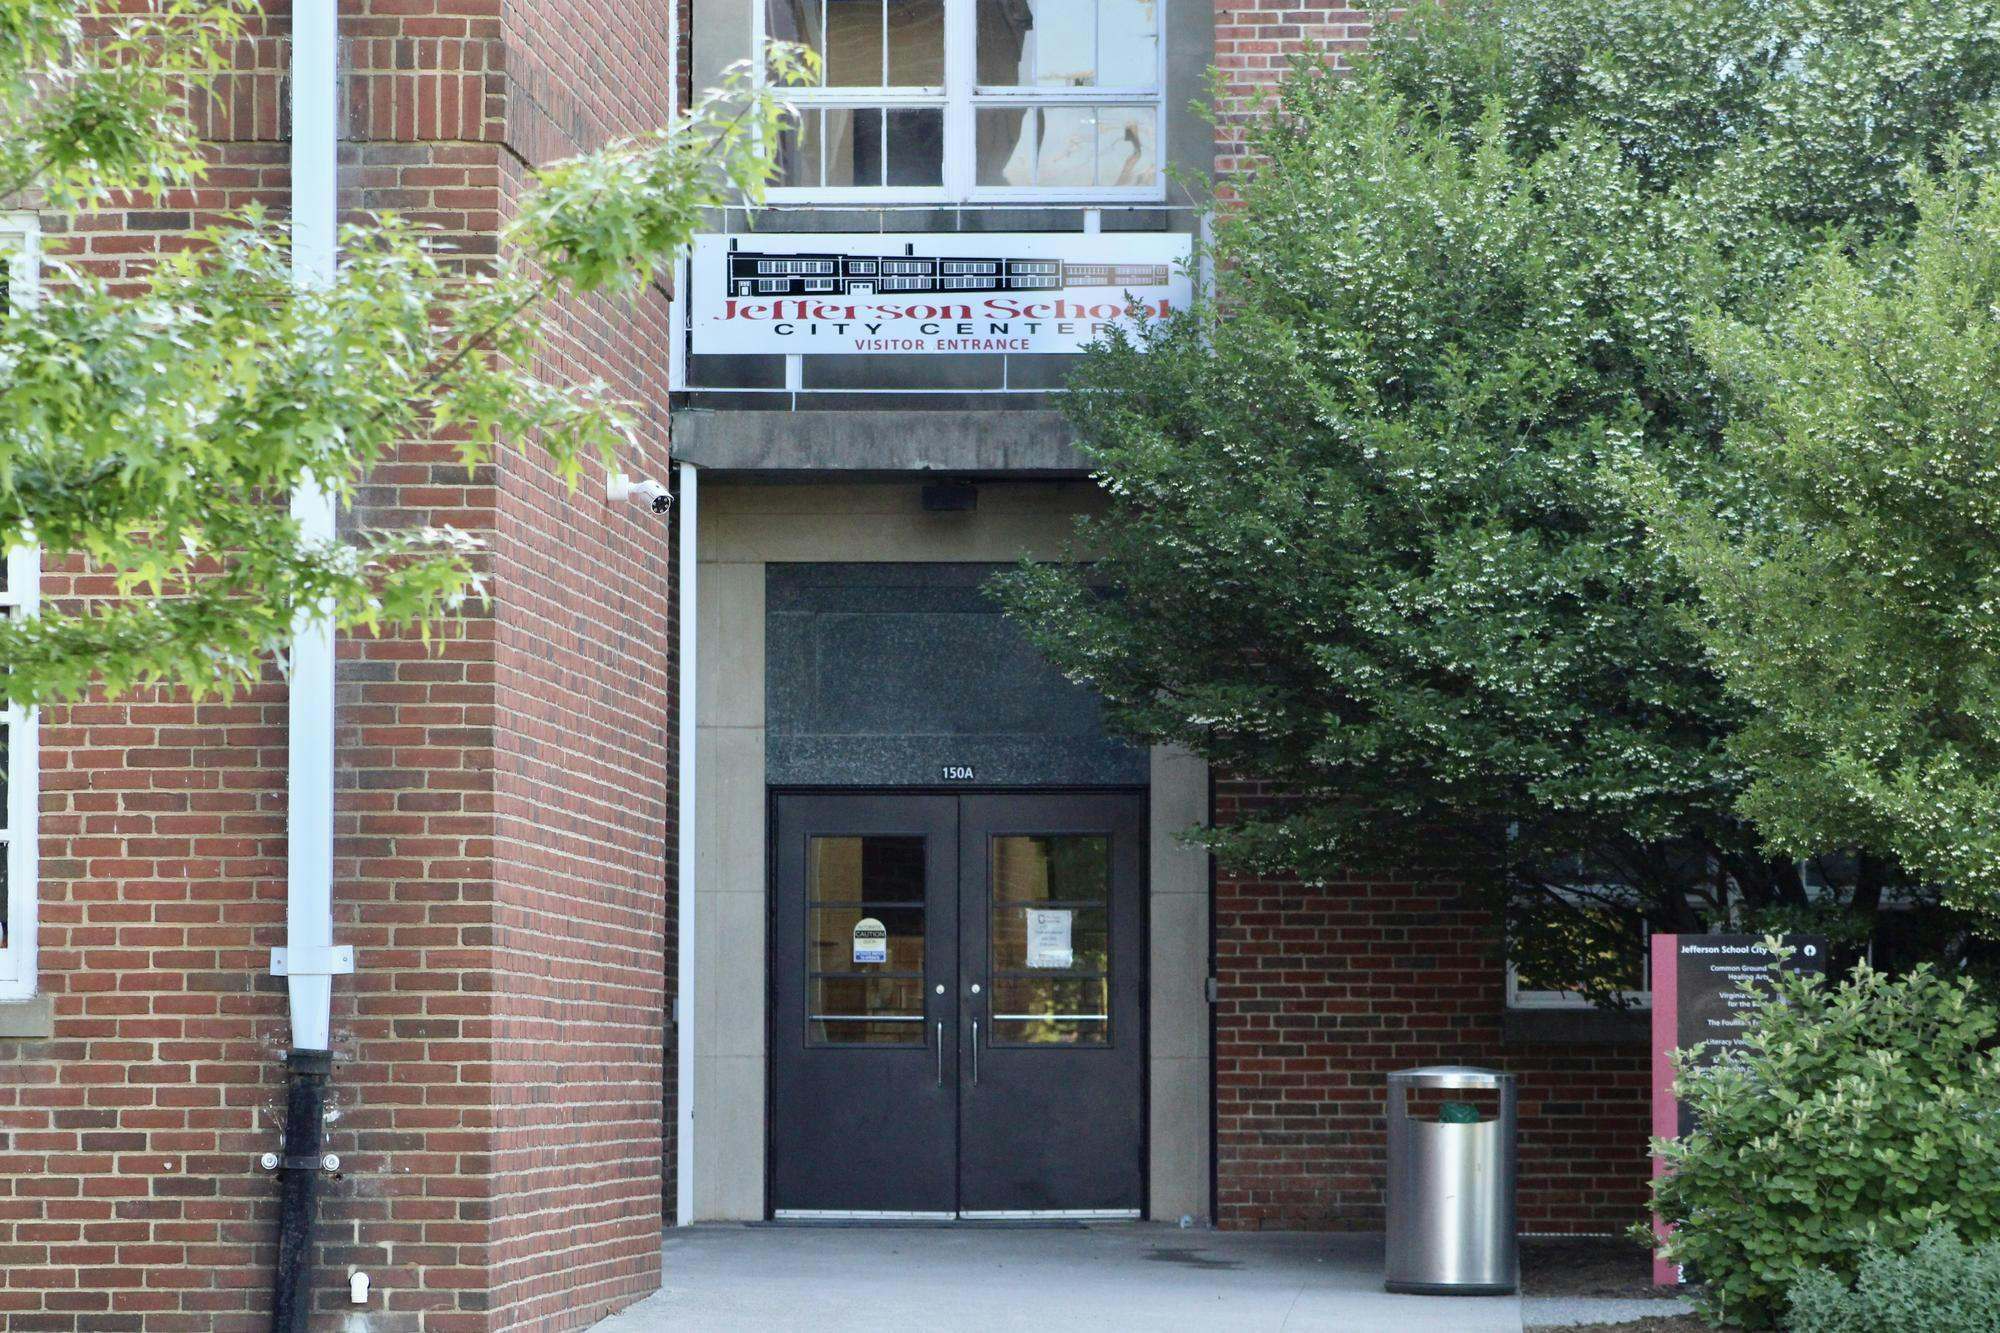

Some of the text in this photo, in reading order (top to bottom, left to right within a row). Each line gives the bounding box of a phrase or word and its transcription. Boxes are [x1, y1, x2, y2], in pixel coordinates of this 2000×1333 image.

[713, 299, 1169, 320] Jefferson School
[774, 323, 1109, 335] CITY CENTER
[855, 339, 1030, 350] VISITOR ENTRANCE
[942, 766, 974, 779] 150A
[1681, 945, 1720, 954] Jefferson
[1721, 945, 1749, 954] School
[1751, 945, 1768, 955] City
[1719, 992, 1746, 1000] Virginia
